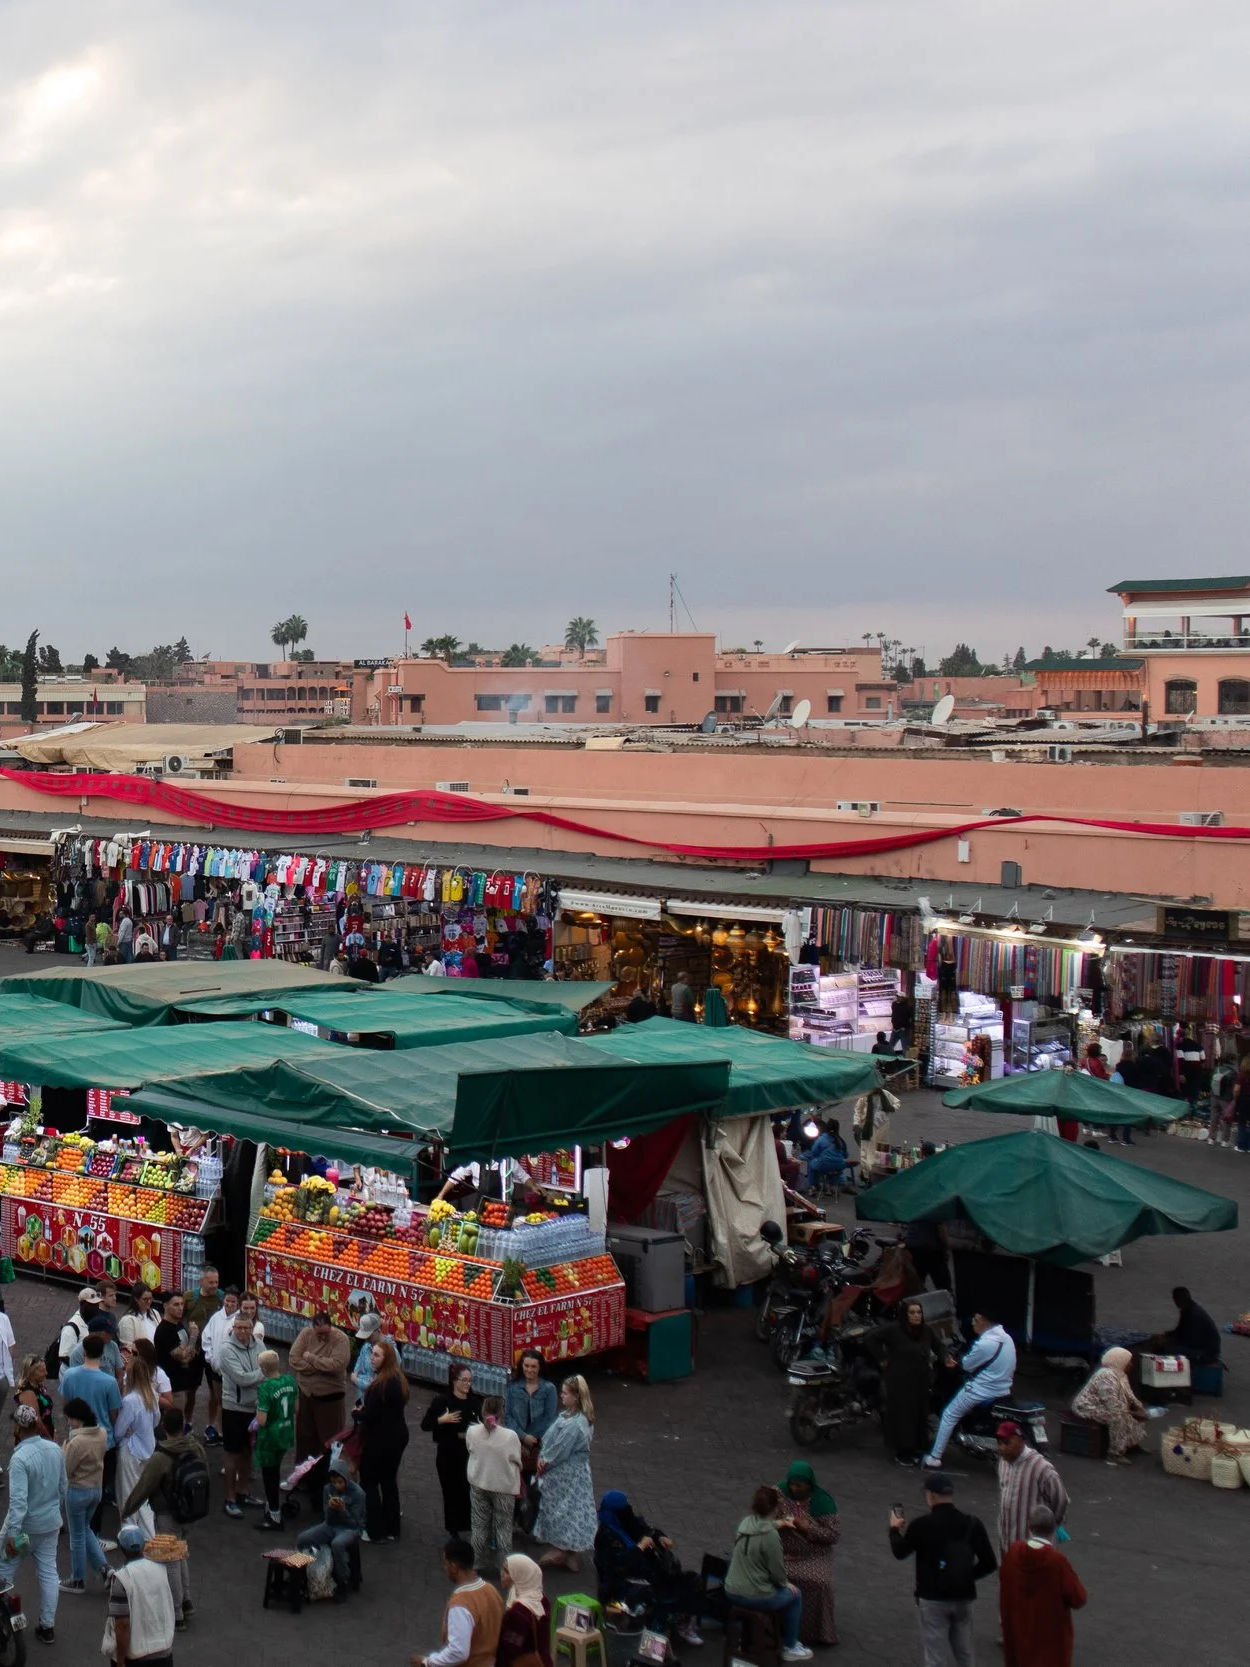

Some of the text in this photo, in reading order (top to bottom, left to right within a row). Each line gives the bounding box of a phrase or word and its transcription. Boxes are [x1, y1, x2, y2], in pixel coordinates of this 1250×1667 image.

[73, 1212, 107, 1232] N 55
[313, 1266, 425, 1302] CHEZ EL FARM N 57
[514, 1297, 593, 1321] CHEZ EL FARM N 57
[280, 1396, 289, 1418] 1
